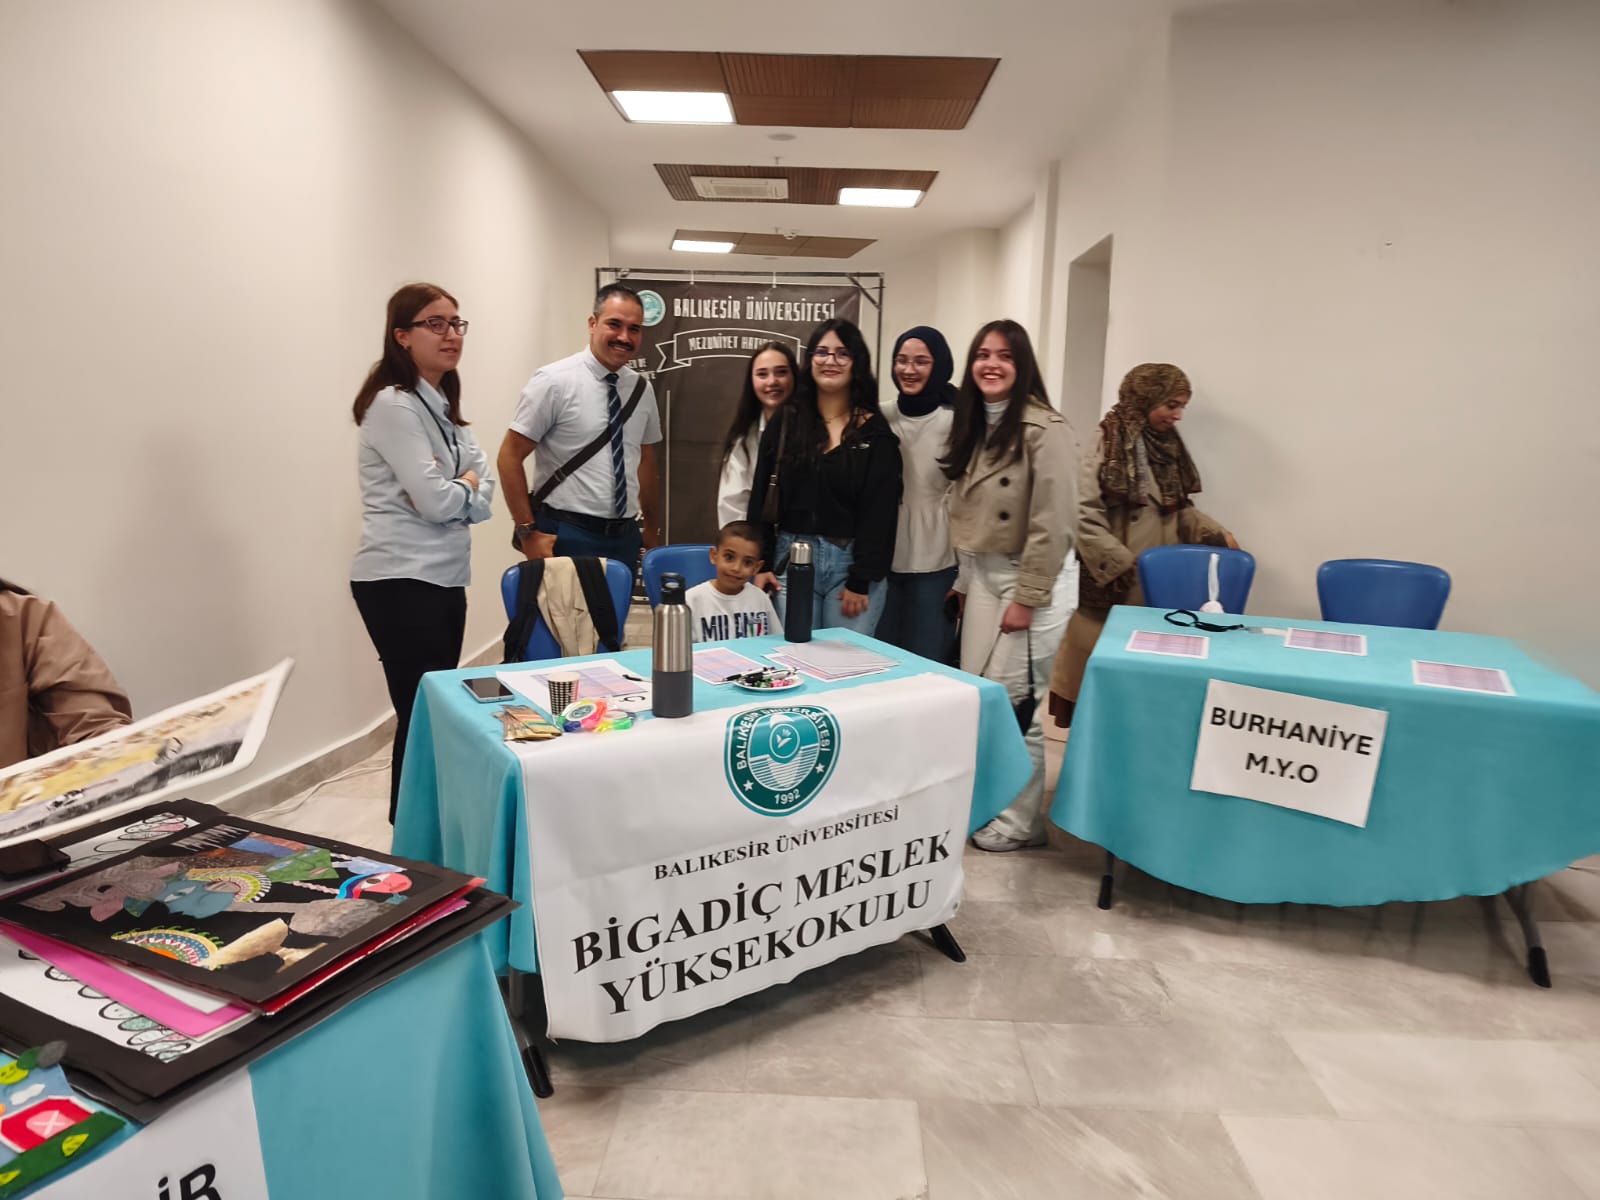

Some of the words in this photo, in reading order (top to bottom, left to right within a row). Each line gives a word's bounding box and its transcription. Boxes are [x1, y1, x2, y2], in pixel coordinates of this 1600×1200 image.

[673, 295, 741, 319] BALIKESİR
[746, 296, 835, 322] ÜNİVERSİTESİ
[688, 332, 738, 351] MEZUNİYET
[1210, 706, 1374, 756] BURHANİYE
[1245, 752, 1319, 784] M.Y.O
[774, 788, 801, 805] 1992
[653, 841, 770, 880] BALIKESİR
[776, 804, 899, 853] ÜNİVERSİTESİ
[571, 882, 783, 974] BİGADİÇ
[793, 829, 952, 907] MESLEK
[598, 878, 933, 1015] YÜKSEKOKULU
